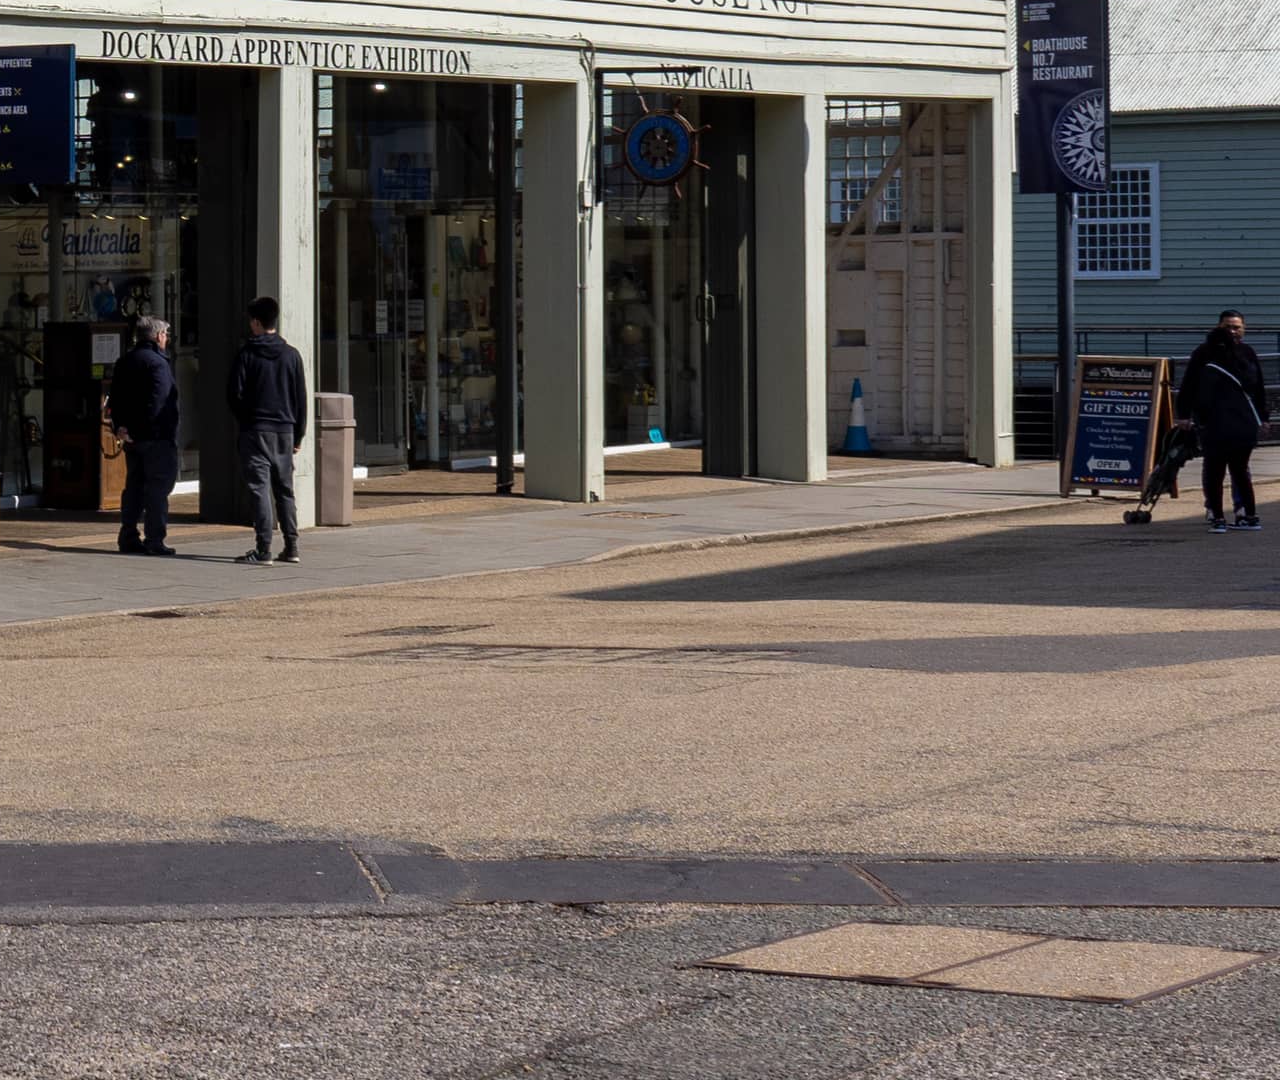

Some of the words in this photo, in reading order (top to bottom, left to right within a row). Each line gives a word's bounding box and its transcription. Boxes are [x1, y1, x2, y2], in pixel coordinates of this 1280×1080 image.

[1032, 36, 1088, 52] BOATHOUSE
[101, 30, 223, 64] DOCKYARD
[230, 36, 355, 69] APPRENTICE
[361, 44, 472, 75] EXHIBITION
[1032, 53, 1055, 66] NO.7
[1032, 65, 1093, 81] RESTAURANT
[13, 105, 28, 114] AREA
[42, 223, 141, 256] auticalia
[1084, 402, 1113, 414] GIFT
[1115, 403, 1148, 415] SHOP
[1096, 460, 1121, 469] OPEN
